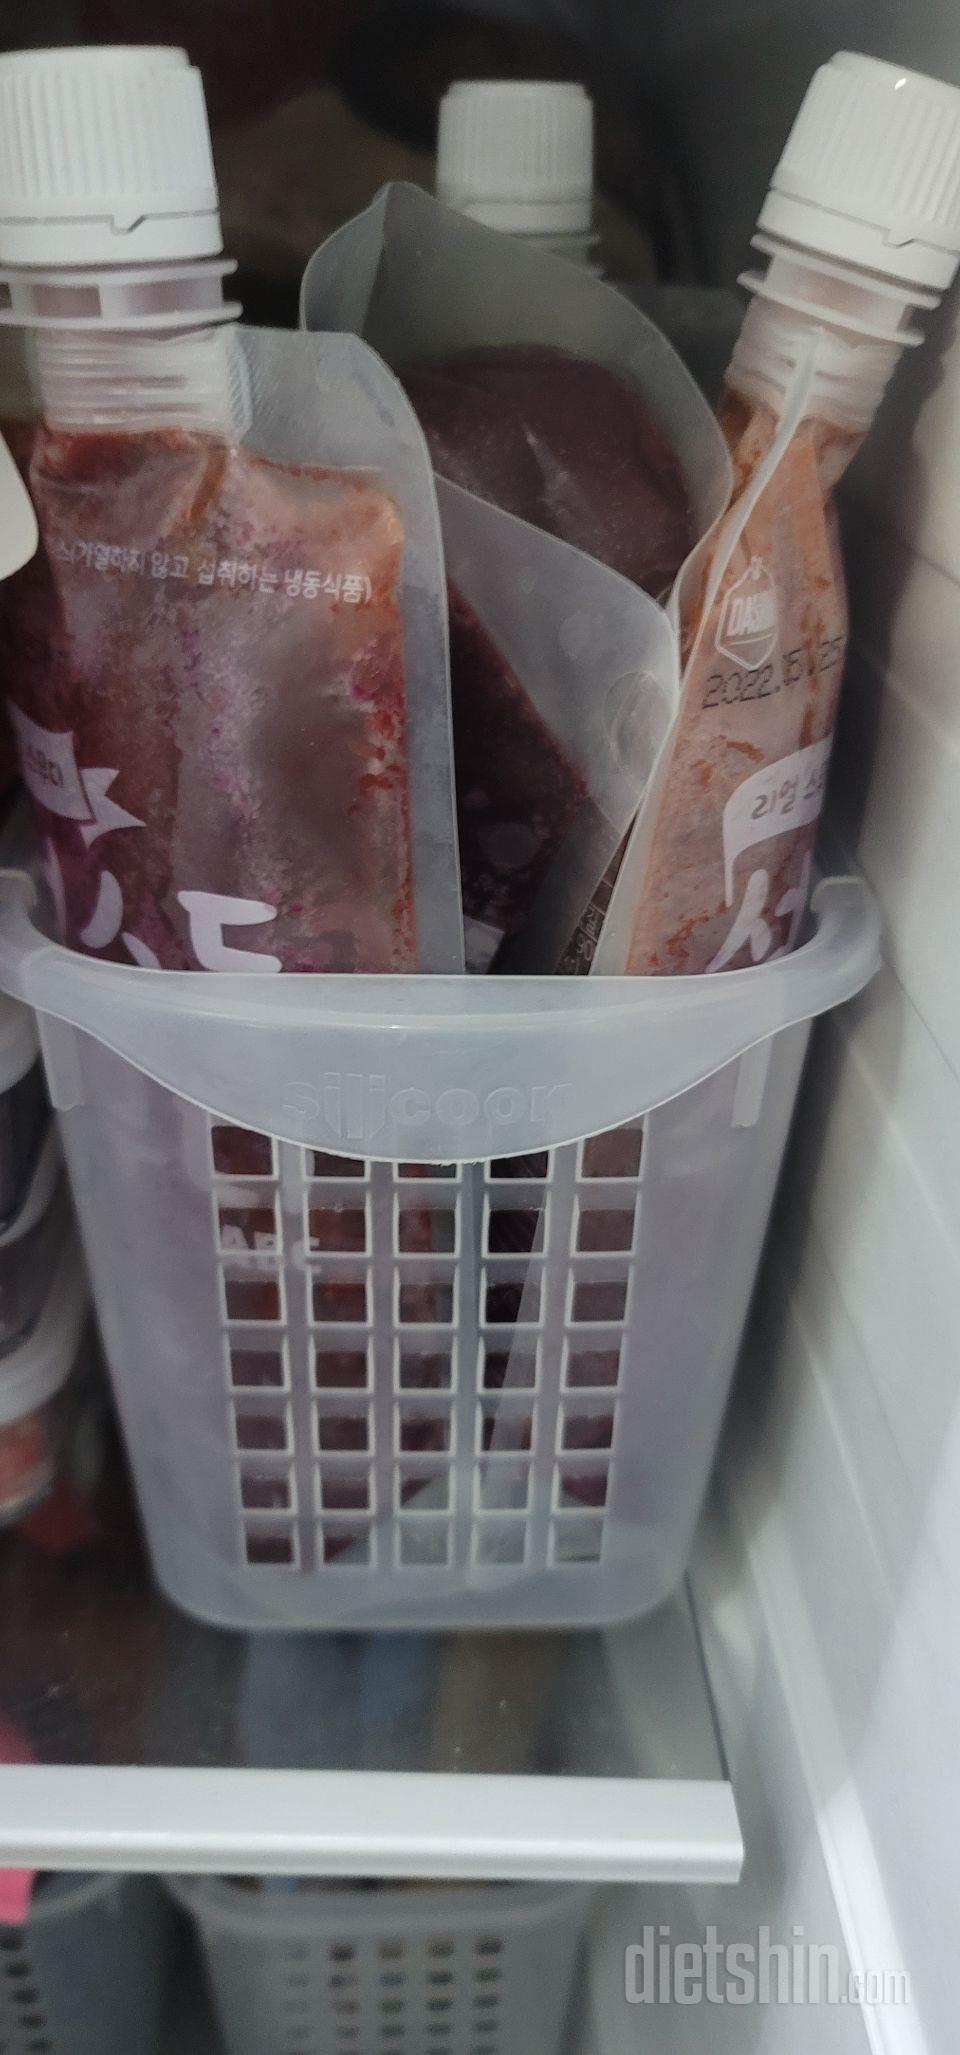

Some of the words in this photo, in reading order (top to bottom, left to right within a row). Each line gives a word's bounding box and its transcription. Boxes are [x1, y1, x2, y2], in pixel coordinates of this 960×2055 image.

[151, 551, 190, 581] 않고
[197, 560, 279, 593] 섭취하는
[284, 568, 373, 605] 냉동식품)
